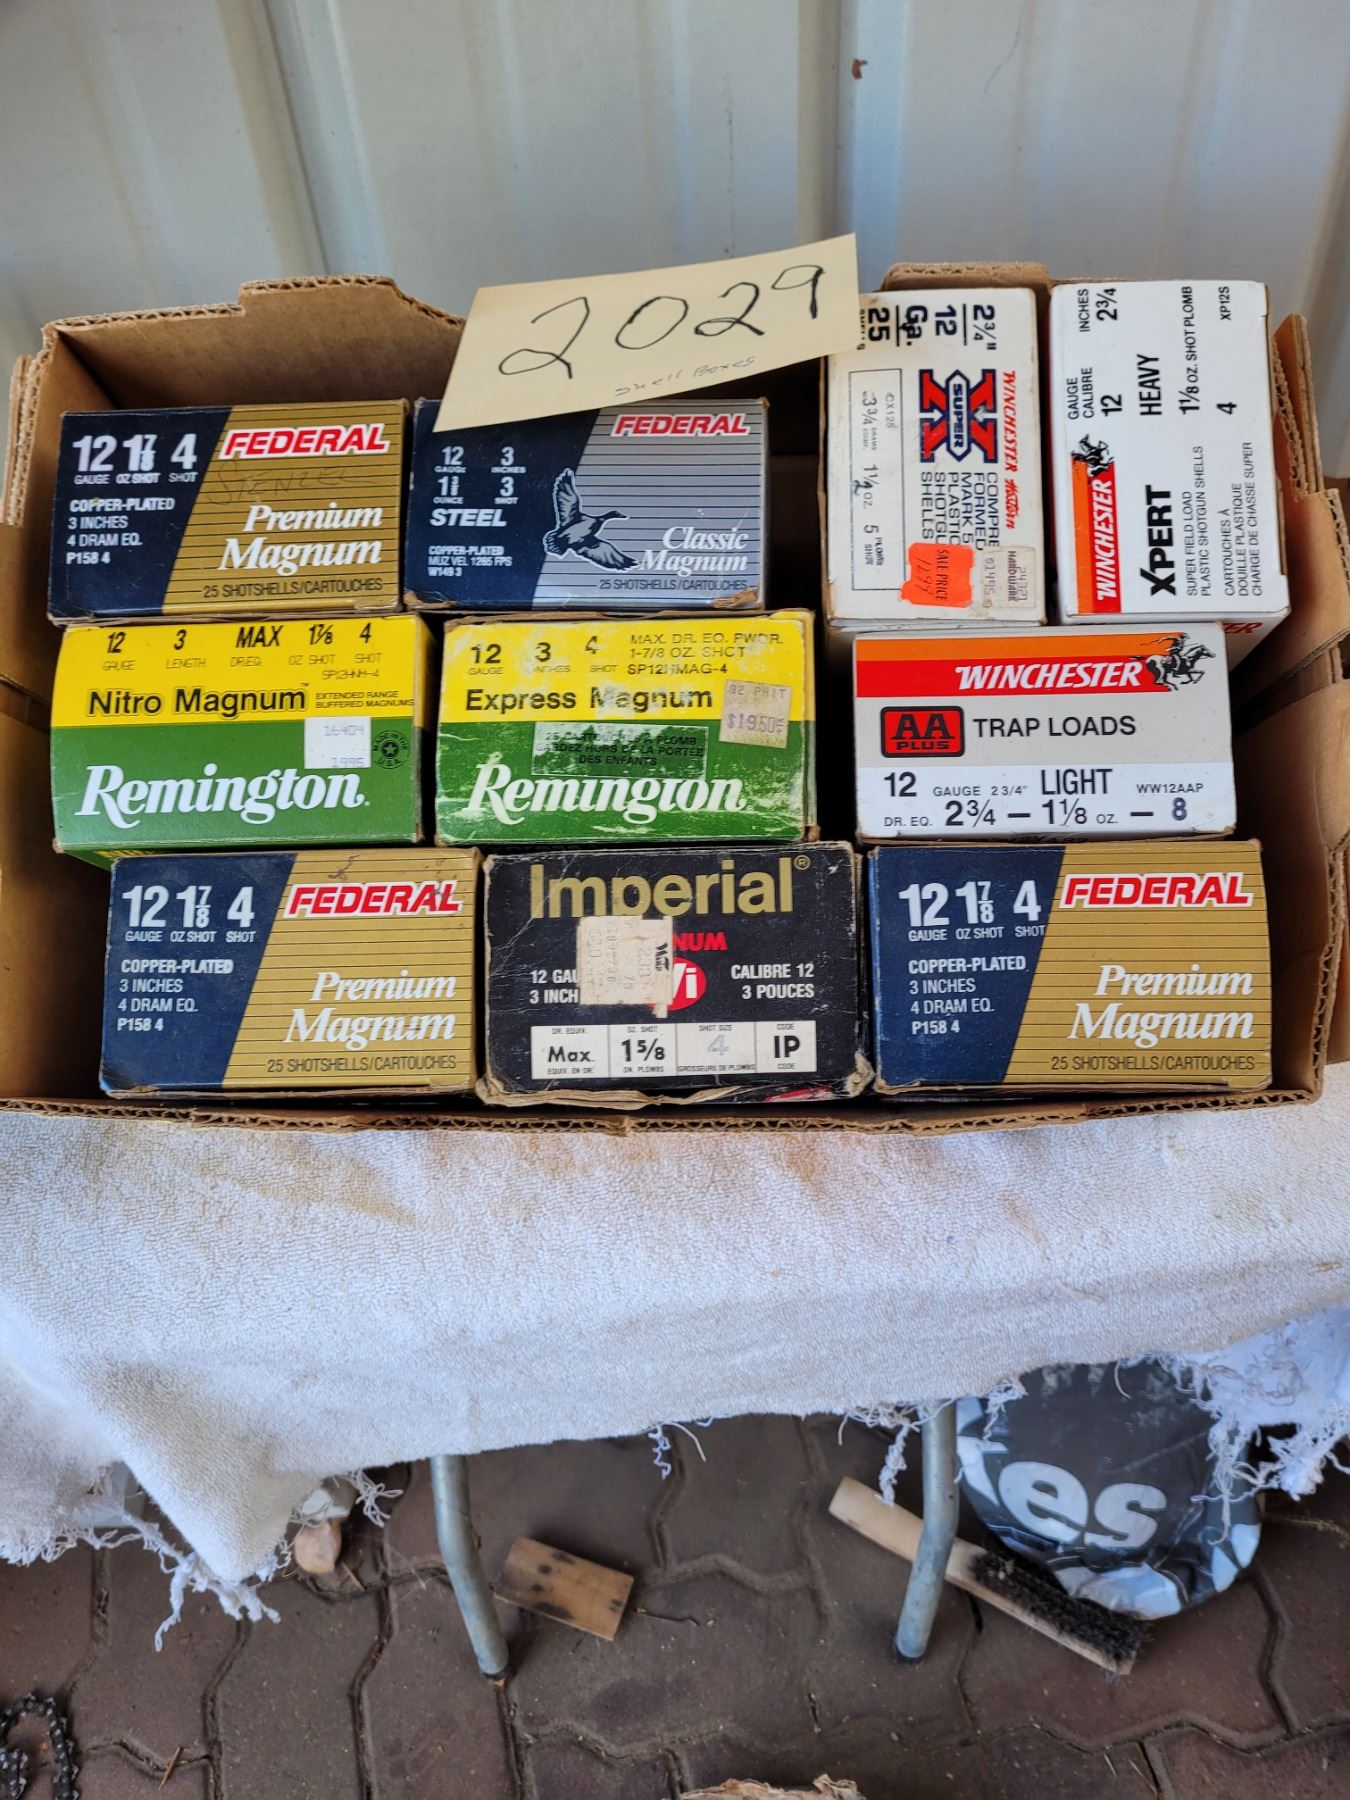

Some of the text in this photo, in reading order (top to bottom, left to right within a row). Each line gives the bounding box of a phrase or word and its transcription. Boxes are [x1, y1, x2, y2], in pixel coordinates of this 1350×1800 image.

[499, 264, 826, 380] 2029
[868, 307, 890, 342] 25
[935, 305, 957, 335] 12
[1181, 286, 1199, 383] OZ. SHOT PLOMB
[1078, 288, 1094, 418] CALIBRE INCHES
[1216, 286, 1238, 415] 4 XP12S
[1066, 377, 1079, 420] GAUGE
[1137, 354, 1162, 416] HEAVY
[952, 384, 964, 447] SUPER
[1100, 394, 1122, 417] 12
[611, 413, 750, 436] FEDERAL
[1003, 370, 1018, 472] WINCHESTER
[72, 433, 197, 473] 12 4
[222, 423, 390, 458] FEDERAL
[442, 446, 515, 466] 12 3
[74, 471, 197, 485] GAUGE SHOT
[500, 477, 515, 497] 3
[69, 497, 175, 512] COPPER-PLATED
[242, 502, 383, 533] Premium
[430, 508, 507, 527] STEEL
[921, 472, 934, 539] SHELLS
[961, 472, 973, 543] MARK 5
[974, 472, 987, 551] FORMED
[987, 472, 1000, 547] COMPRE
[68, 515, 128, 530] 3 INCHES
[864, 525, 879, 534] 5
[1193, 446, 1211, 596] PLASTIC SHOTGUN SHELLS
[1242, 442, 1262, 596] CHARGE DE CHASSE SUPER
[67, 533, 119, 547] 4 DRAM
[428, 546, 505, 556] COPPER-PLATED
[661, 525, 749, 551] Classic
[1091, 479, 1116, 600] WINCHESTER
[1140, 485, 1176, 596] XPERT
[1182, 491, 1197, 596] SUPER FIELD LOAD
[1231, 483, 1249, 596] DOUILLE PLASTIQUE
[66, 552, 111, 565] P158 4
[217, 535, 381, 577] Magnum
[638, 549, 748, 577] Magnum
[1219, 519, 1235, 596] CARTOUCHES
[203, 578, 383, 598] 25 SHOTSHELLS/CARTOUCHES
[599, 578, 748, 591] 25 SHOTSHELLS/CARTOUCHES
[936, 549, 949, 601] SALE PRICE
[107, 623, 372, 653] 12 3 MAX 4
[470, 636, 599, 664] 12 3 4
[702, 646, 746, 658] SHOT
[955, 661, 1143, 691] WINCHESTER
[88, 688, 306, 718] Nitro Magnum
[315, 690, 400, 700] EXTENDED RANGE
[315, 698, 415, 709] BUFFERED MAGNUMS
[465, 687, 713, 714] Express Magnum
[891, 713, 955, 740] AA
[973, 715, 1136, 739] TRAP LOADS
[579, 755, 601, 764] DES
[895, 740, 950, 751] PLUS
[74, 763, 365, 830] Remington
[462, 751, 750, 826] Remington
[884, 768, 1204, 798] 12 GAUGE LIGHT WW12AAP
[884, 796, 1188, 827] DR. EQ. OZ. 8
[285, 881, 462, 917] FEDERAL
[530, 857, 794, 919] Imperial
[1061, 874, 1254, 907] FEDERAL
[122, 885, 255, 928] 12 4
[898, 880, 1042, 927] 12 4
[125, 930, 256, 943] GAUGE SHOT SHOT
[908, 925, 1046, 942] GAUGE OZ SHOT SHOT
[121, 959, 234, 974] COPPER-PLATED
[530, 970, 548, 984] 12
[731, 964, 815, 980] CALIBRE 12
[908, 955, 1027, 975] COPPER-PLATED
[119, 978, 184, 993] 3 INCHES
[309, 969, 456, 1002] Premium
[741, 983, 815, 1000] 3 POUCES
[909, 978, 977, 995] 3 INCHES
[1093, 963, 1254, 997] Premium
[118, 998, 199, 1012] 4 DRAM EQ.
[530, 991, 540, 1005] 3
[910, 997, 995, 1015] 4 DRAM EQ.
[117, 1018, 164, 1031] P158 4
[282, 1007, 456, 1051] Magnum
[911, 1019, 961, 1035] P158 4
[1066, 1002, 1254, 1049] Magnum
[706, 1034, 729, 1057] 4
[773, 1035, 801, 1060] IP
[266, 1056, 457, 1072] 25 SHOTSHELLS/CARTOUCHES
[1050, 1055, 1256, 1071] 25 SHOTSHELLS/CARTOUCHES
